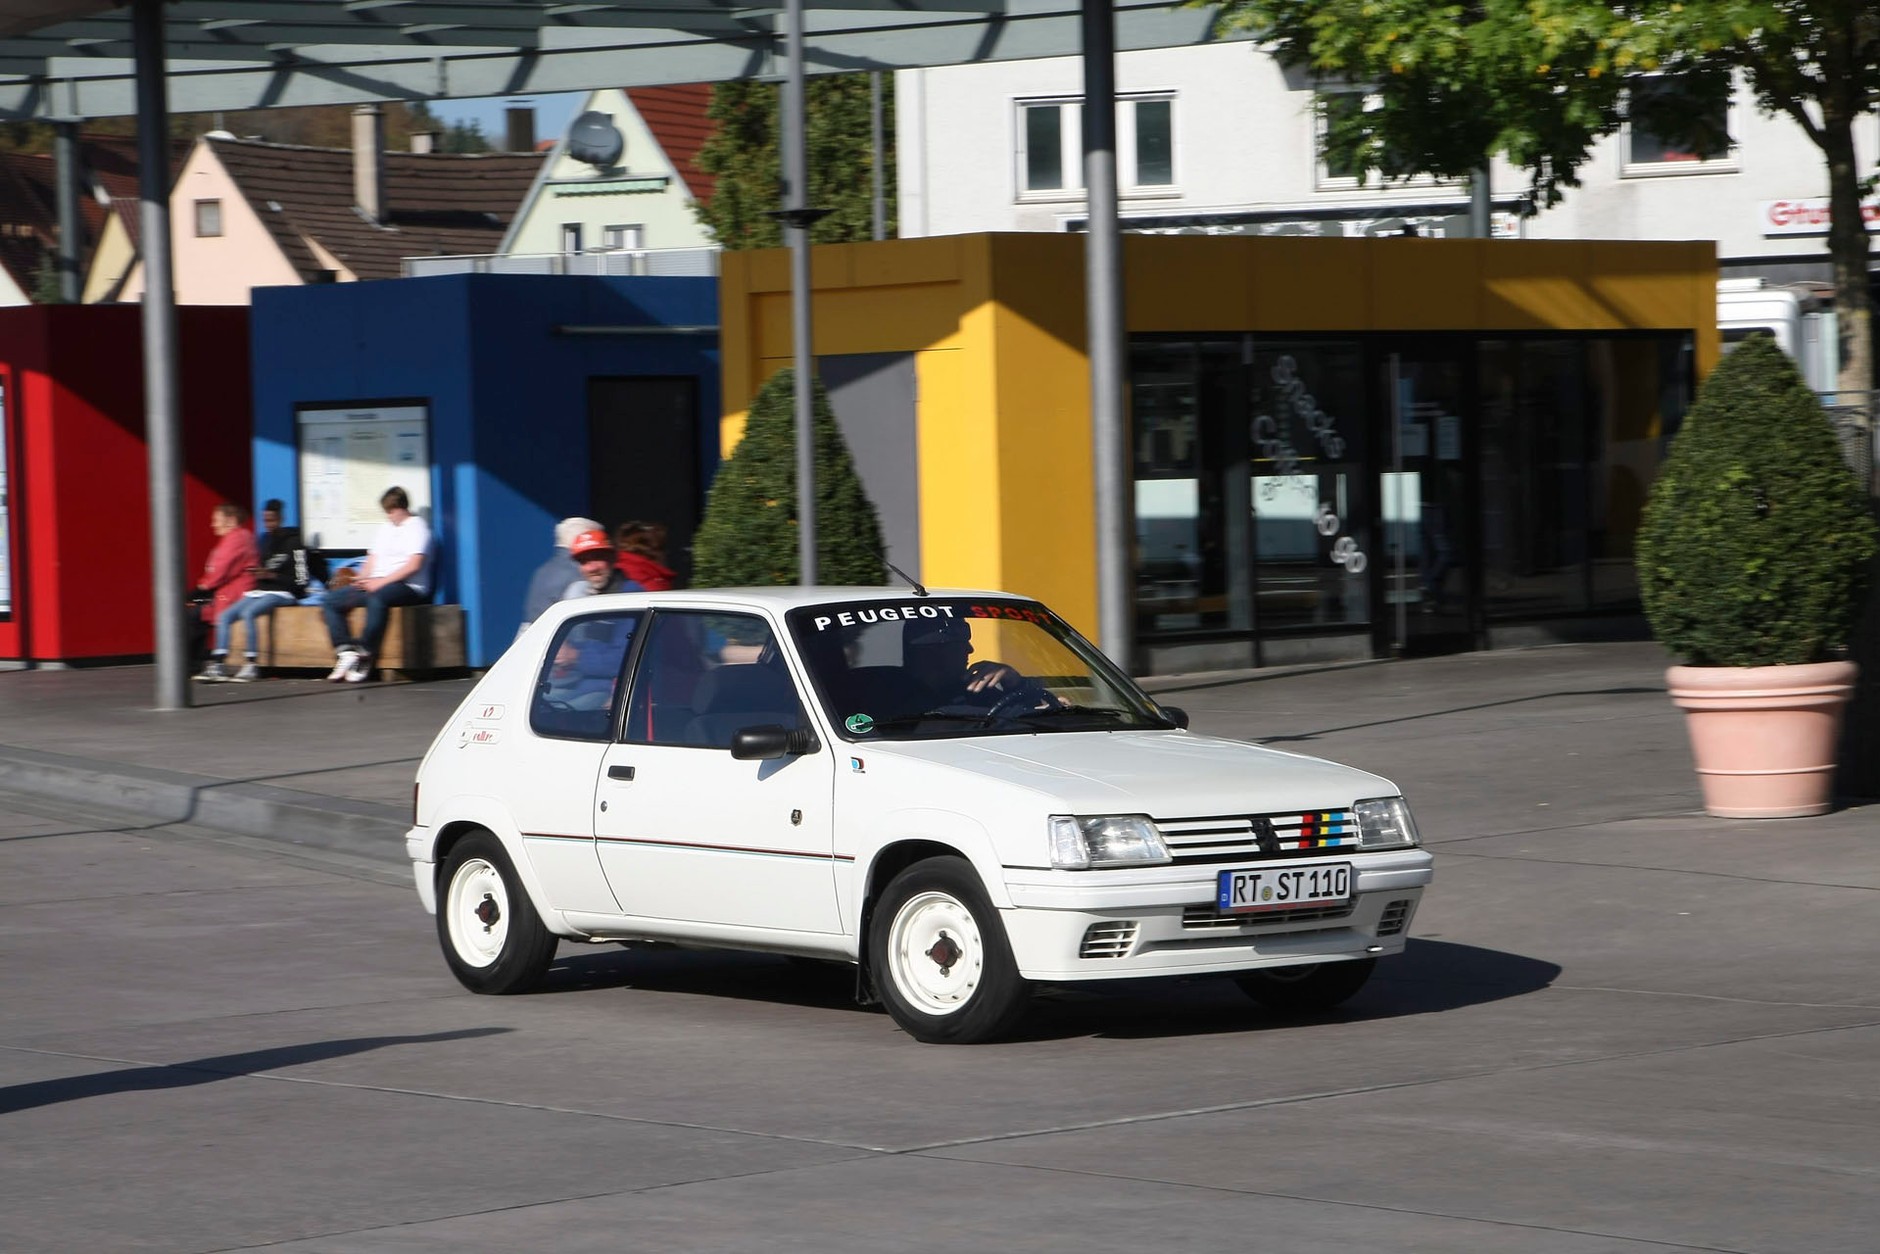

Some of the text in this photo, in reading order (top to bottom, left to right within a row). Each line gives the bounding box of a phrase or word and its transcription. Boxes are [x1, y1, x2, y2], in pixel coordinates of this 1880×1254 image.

[813, 604, 1053, 632] PEUGEOT SPORT
[1233, 868, 1347, 903] RT ST 110
